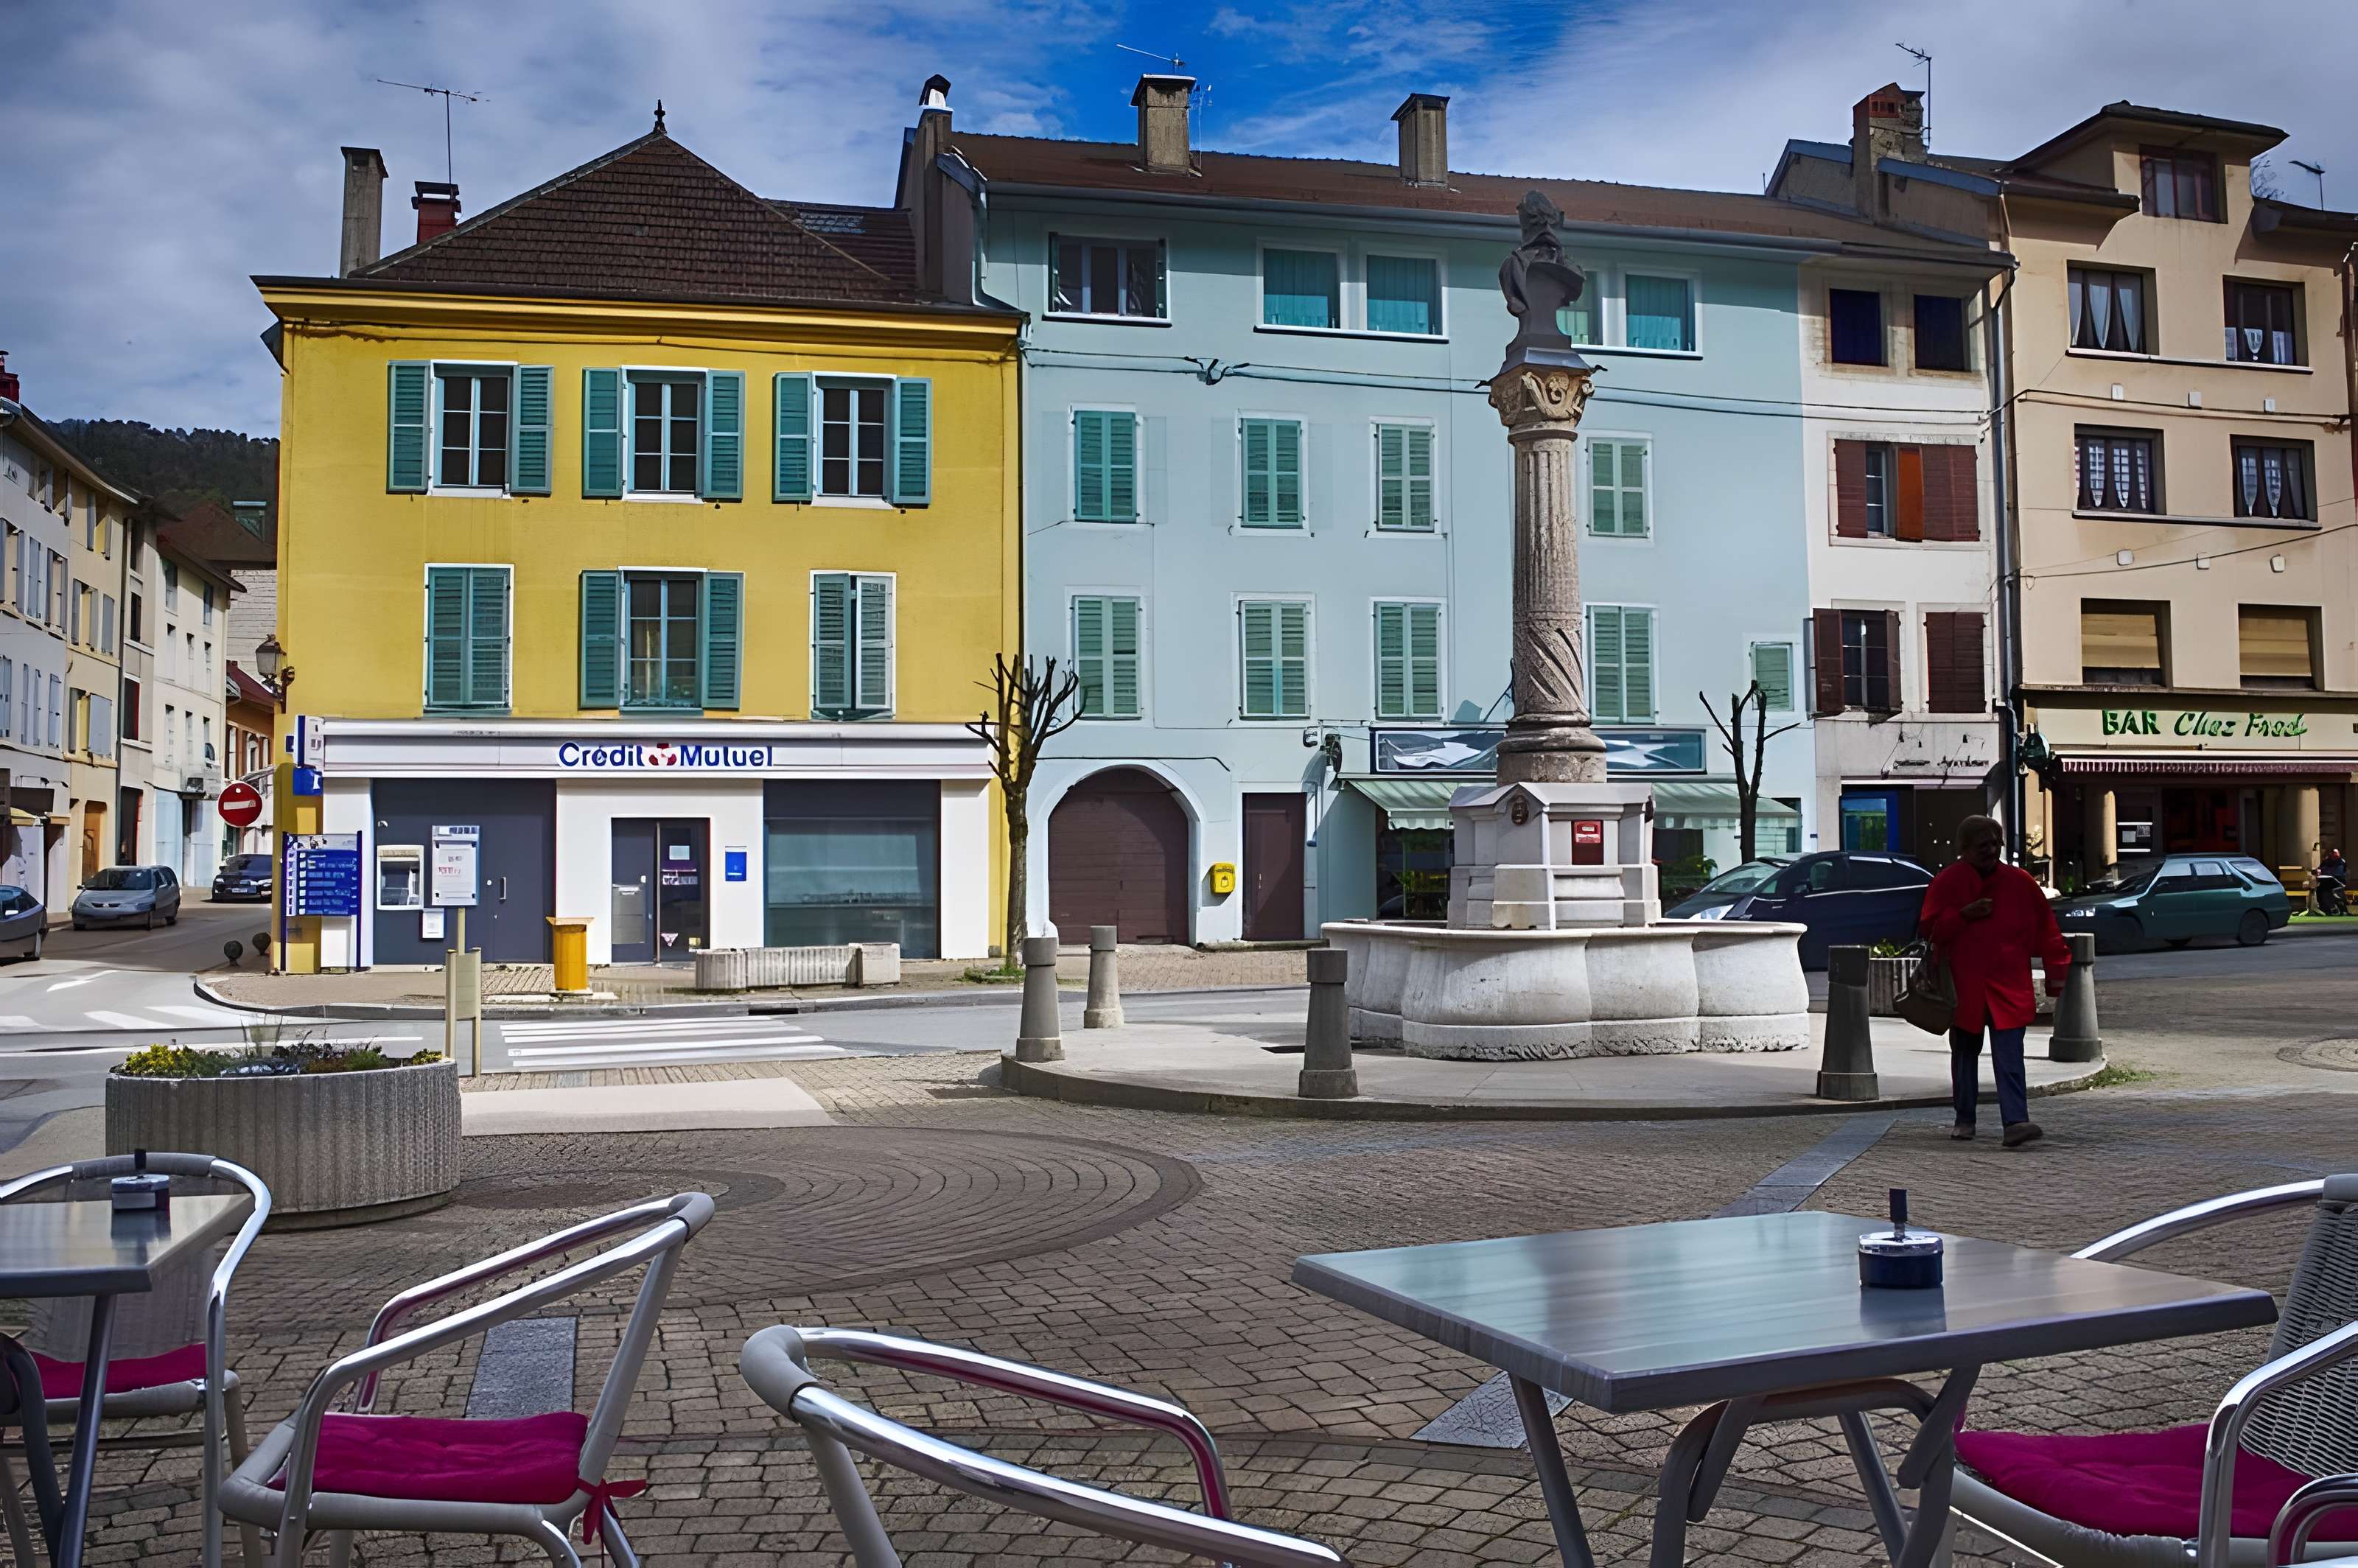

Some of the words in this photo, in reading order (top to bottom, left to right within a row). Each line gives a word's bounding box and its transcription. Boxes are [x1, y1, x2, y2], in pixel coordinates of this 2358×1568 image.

[2102, 710, 2161, 736] BAR
[2173, 711, 2237, 737] Chez
[559, 741, 645, 767] Crédit
[679, 744, 773, 767] Mutuel
